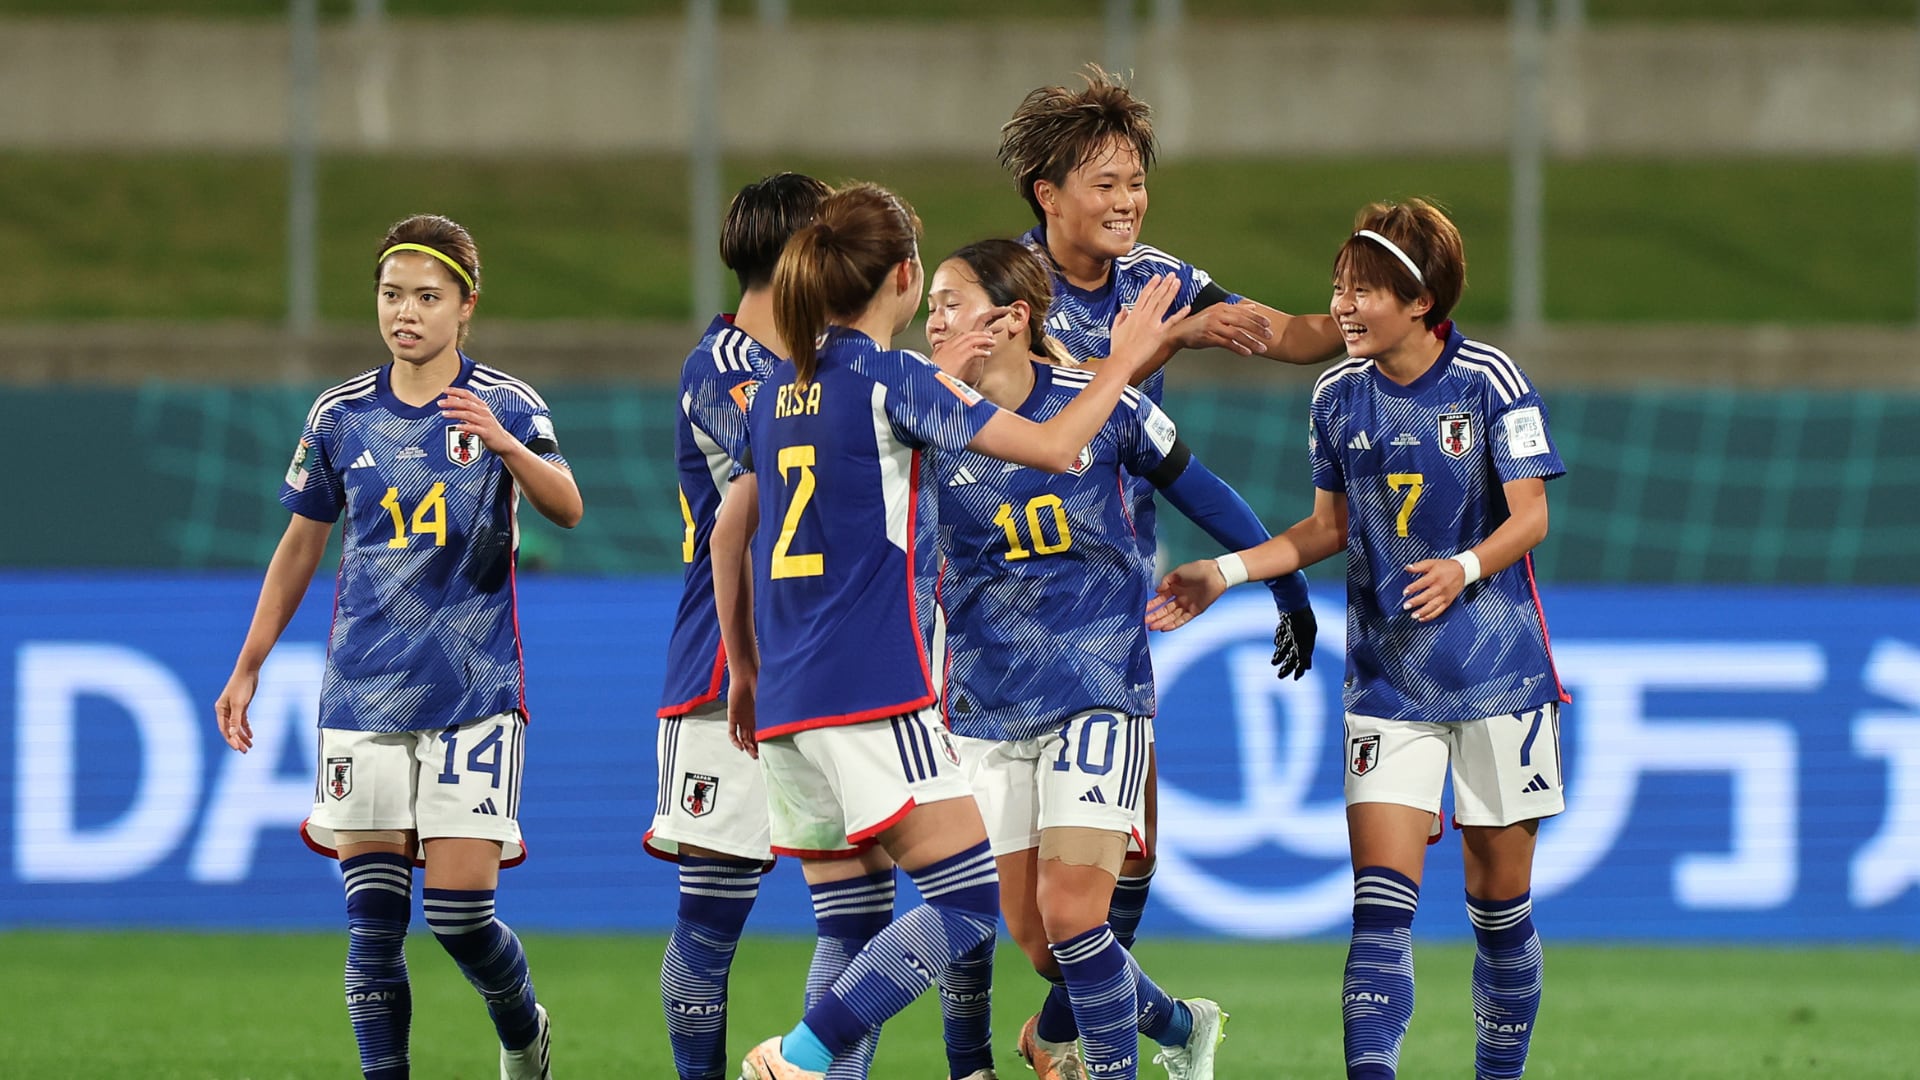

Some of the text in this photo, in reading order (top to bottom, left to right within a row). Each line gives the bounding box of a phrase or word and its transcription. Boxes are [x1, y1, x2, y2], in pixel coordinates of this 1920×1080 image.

[775, 382, 822, 419] RISA
[380, 482, 447, 549] 14
[771, 445, 824, 580] 2
[992, 493, 1073, 562] 10
[1387, 473, 1424, 538] 7
[438, 724, 504, 789] 14
[1052, 713, 1119, 777] 10
[1513, 704, 1544, 768] 7
